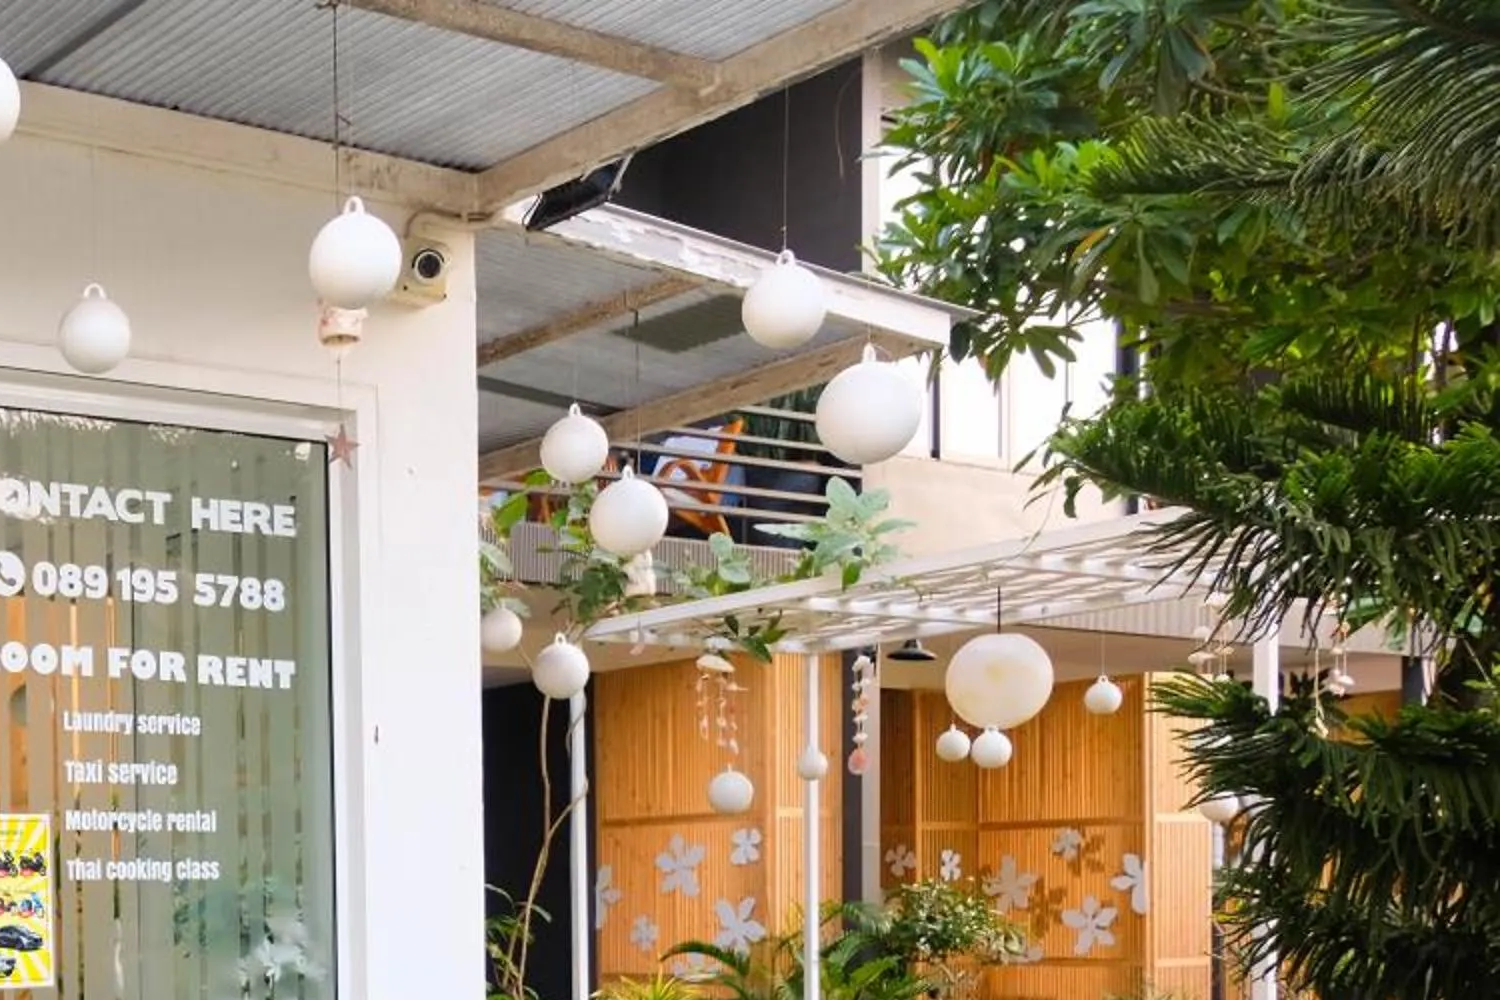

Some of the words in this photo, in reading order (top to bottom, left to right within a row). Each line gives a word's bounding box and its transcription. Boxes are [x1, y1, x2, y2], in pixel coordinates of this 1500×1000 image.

[191, 497, 297, 537] HERE
[32, 561, 109, 600] 089
[116, 568, 179, 604] 195
[193, 573, 286, 612] 5788
[107, 647, 187, 683] FOR
[197, 654, 297, 690] RENT
[63, 710, 133, 735] Laundry
[137, 714, 201, 736] service
[64, 759, 102, 783] Taxi
[108, 760, 179, 785] service
[65, 808, 163, 833] Motorcycle
[167, 810, 217, 833] rental
[66, 857, 101, 881] Thai
[106, 858, 172, 882] cooking
[176, 857, 220, 880] class
